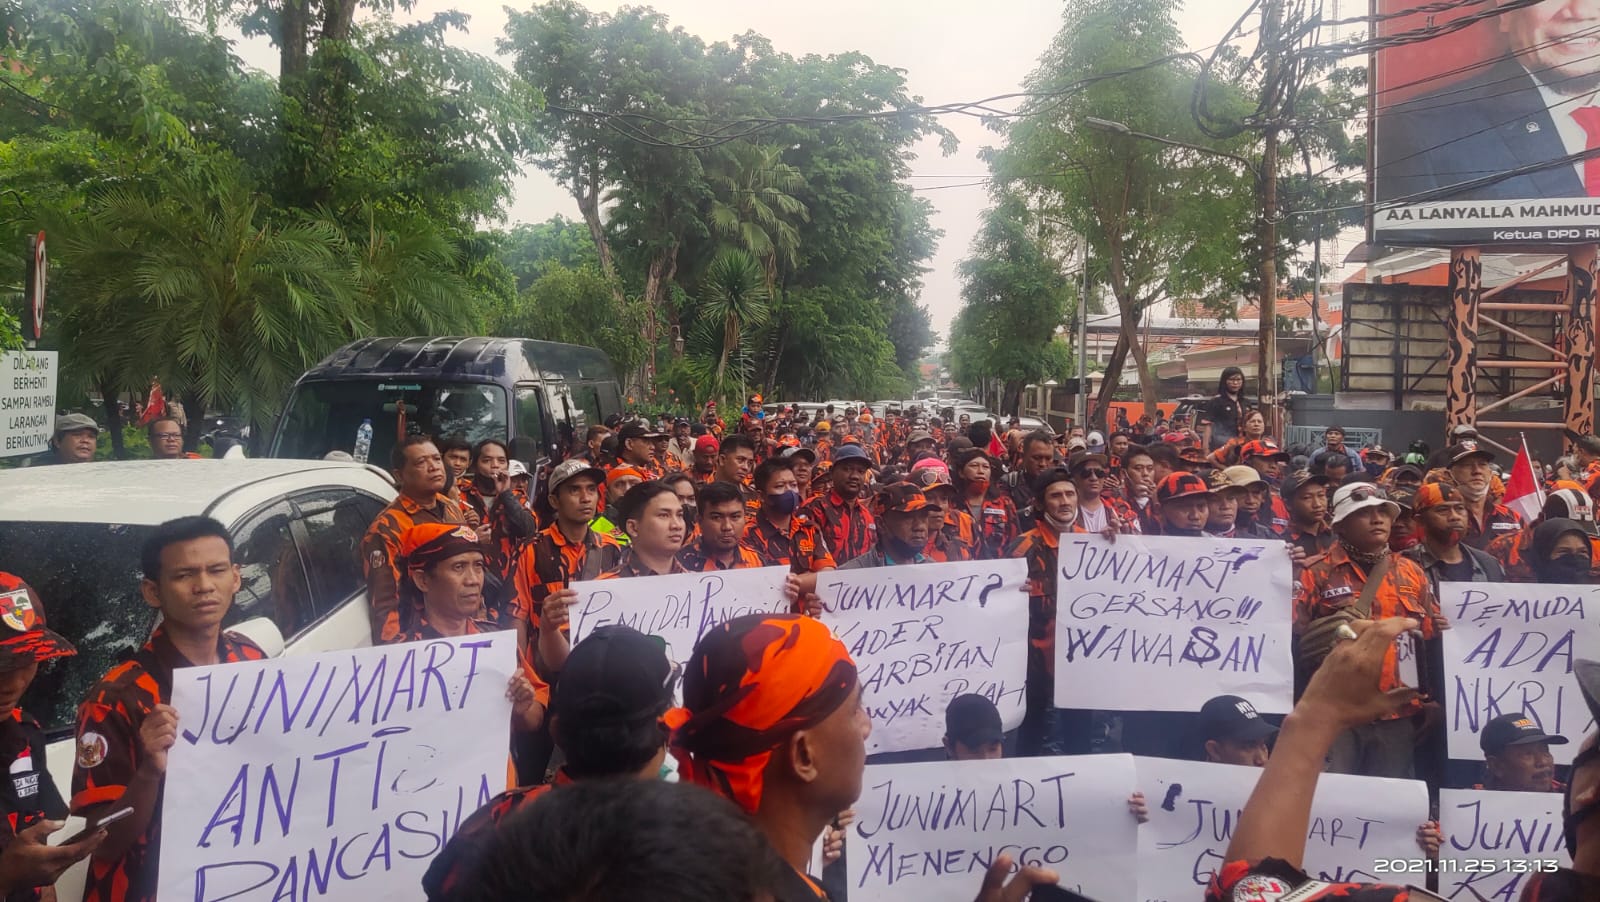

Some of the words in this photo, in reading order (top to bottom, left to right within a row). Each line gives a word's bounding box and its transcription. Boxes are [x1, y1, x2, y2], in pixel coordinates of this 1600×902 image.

[1386, 207, 1413, 221] AA
[1419, 206, 1514, 220] LANYALLA
[1493, 230, 1543, 240] Ketua
[1547, 229, 1580, 239] DPD
[1585, 228, 1600, 238] RI
[13, 376, 48, 390] BERHENTI
[1, 396, 32, 410] SAMPAI
[33, 395, 55, 409] RAMBU
[9, 415, 48, 430] LARANGAN
[6, 433, 49, 450] BERIKUTNYA
[1456, 590, 1585, 623] PEMUDA
[1065, 624, 1266, 673] WAWASAN
[1463, 627, 1576, 674] ADA
[857, 637, 1001, 694] ARBITAN
[182, 640, 493, 745] JUNIMART
[1454, 675, 1564, 735] NKRI
[196, 727, 412, 848] ANTI
